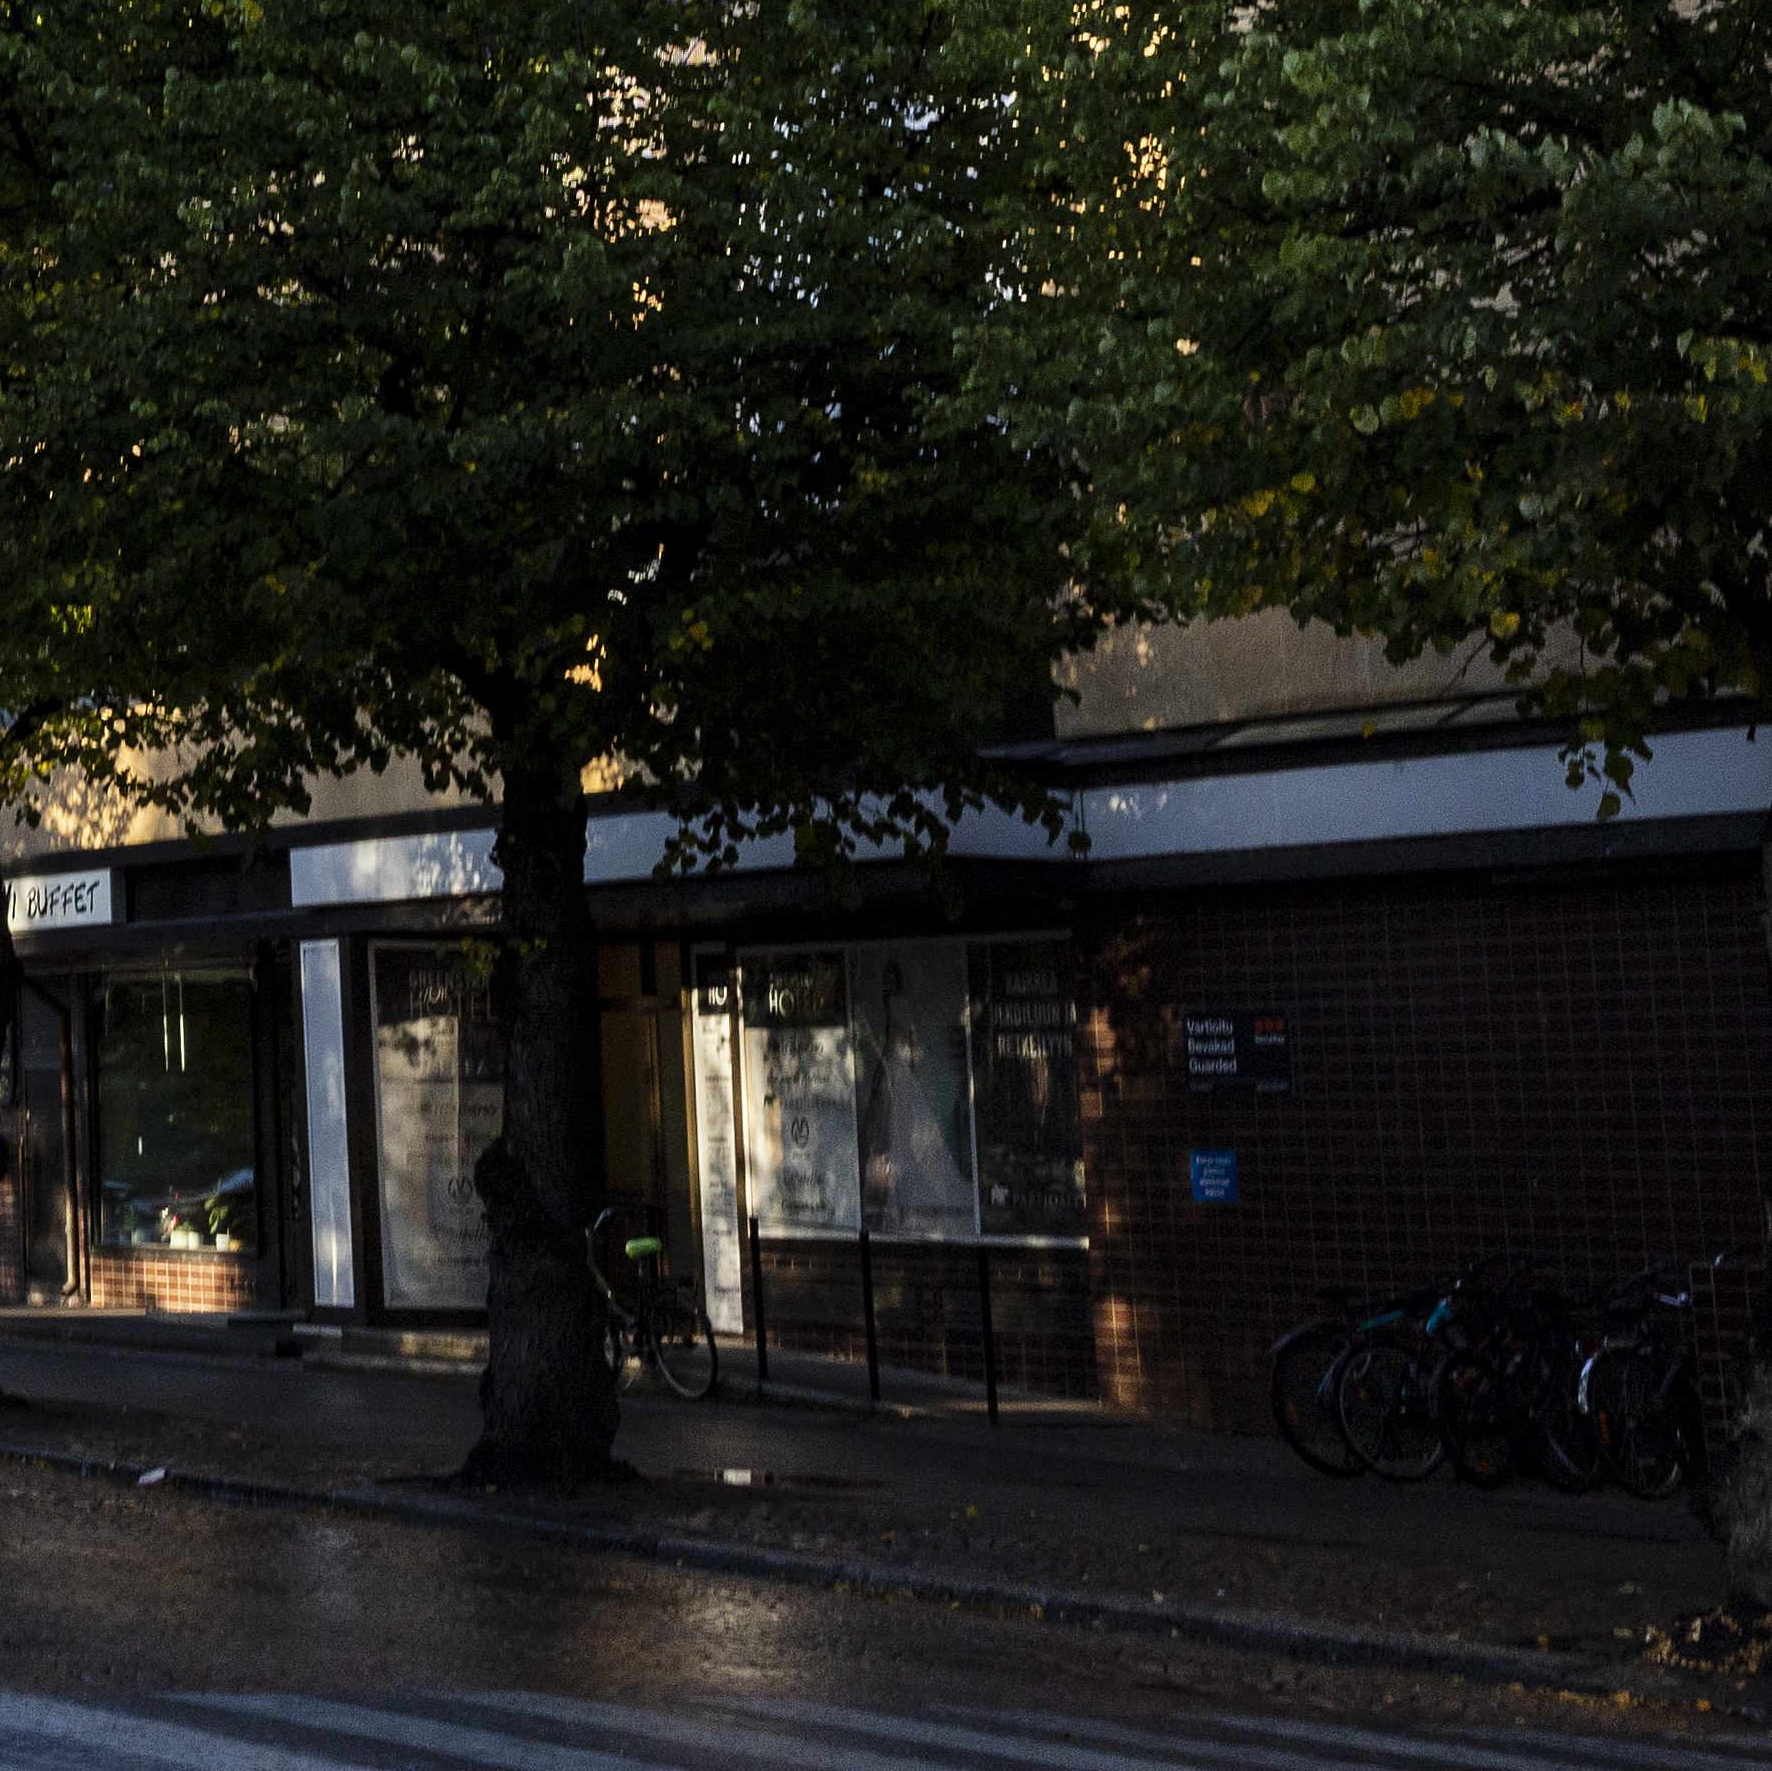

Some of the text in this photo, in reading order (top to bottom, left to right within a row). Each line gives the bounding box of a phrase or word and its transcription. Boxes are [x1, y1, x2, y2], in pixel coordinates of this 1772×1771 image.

[27, 880, 101, 918] BUFFET
[1187, 1037, 1236, 1055] Bevakad
[1188, 1056, 1238, 1074] Guarded
